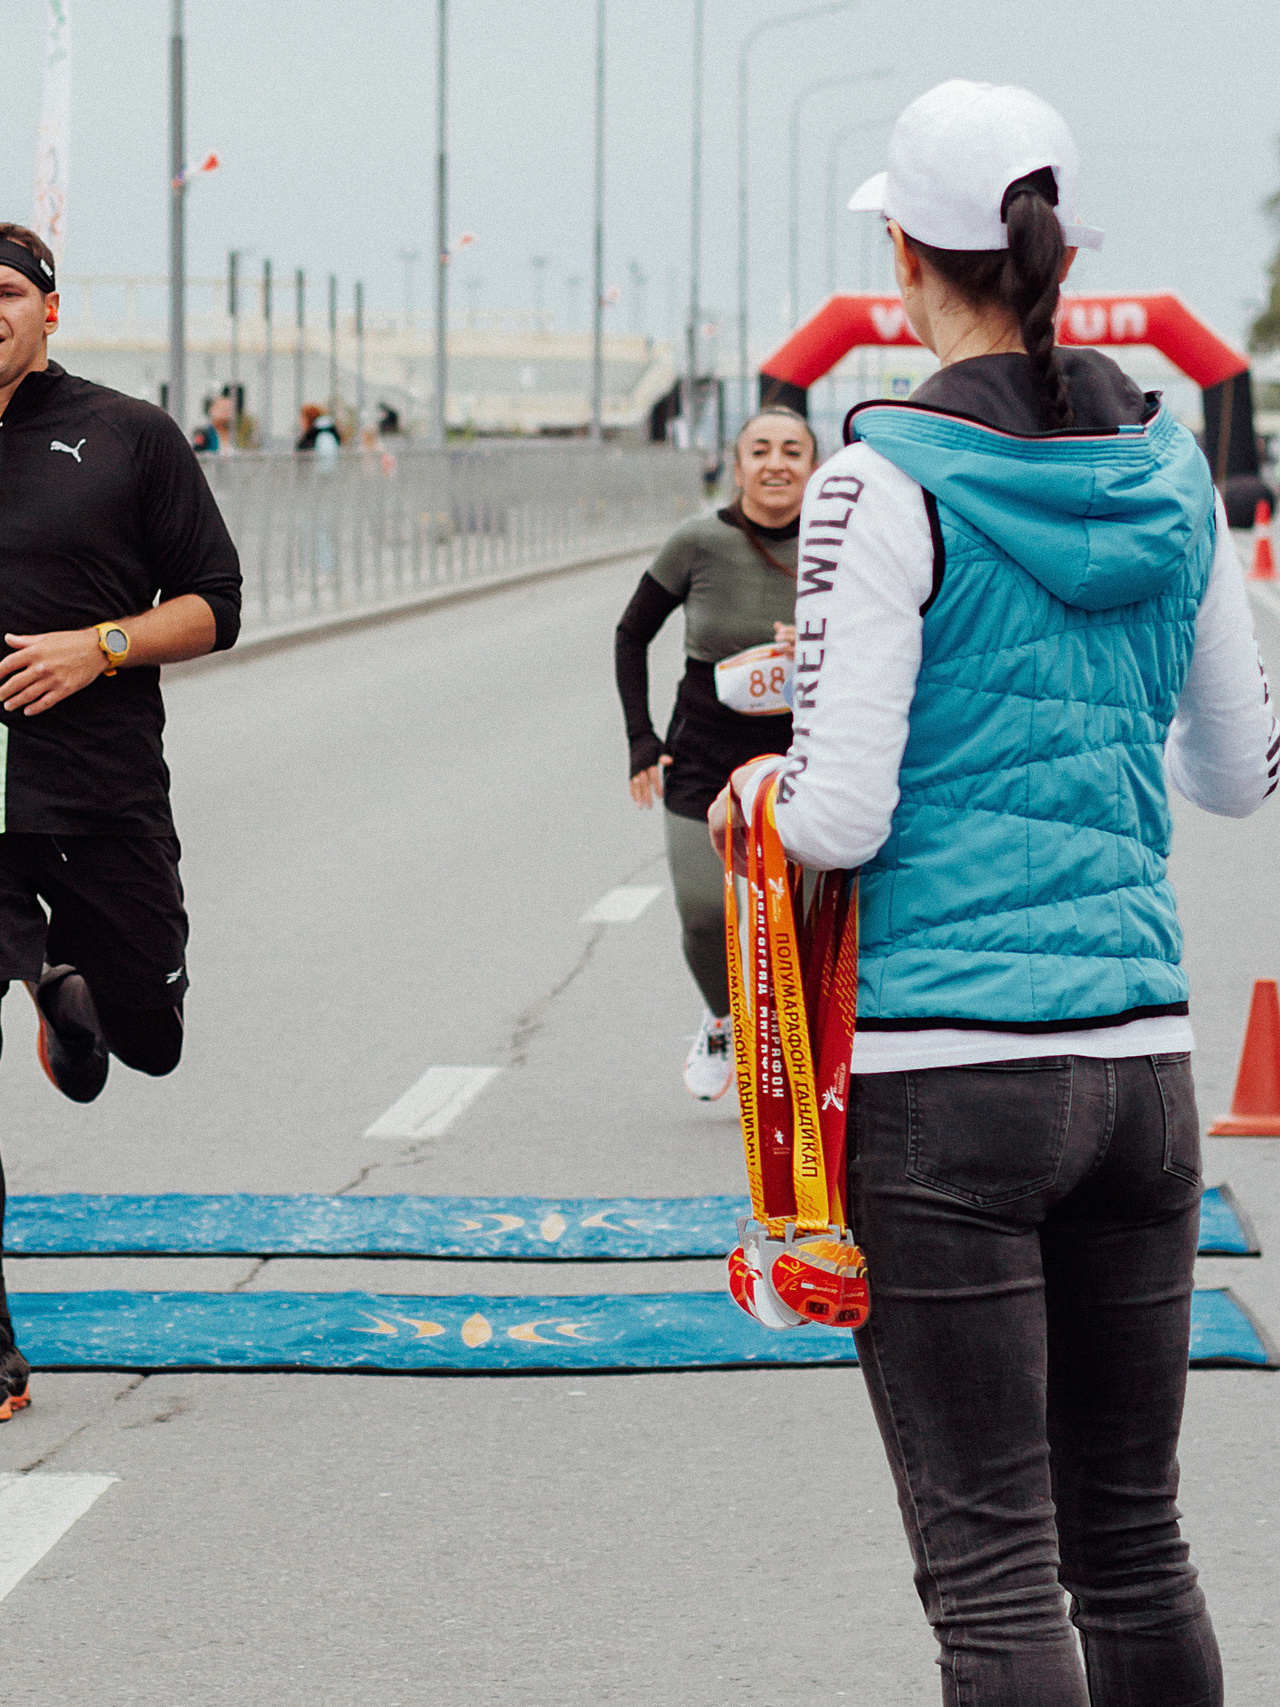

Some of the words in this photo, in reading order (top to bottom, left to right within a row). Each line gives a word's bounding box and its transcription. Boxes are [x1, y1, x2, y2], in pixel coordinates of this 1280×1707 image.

[798, 476, 865, 598] WILD
[749, 666, 786, 697] 88
[726, 924, 748, 1066] ПОЛУМАРАФОН
[775, 932, 805, 1075] ПОЛУМАРАФОН
[797, 1082, 818, 1178] ГАНДИКАП
